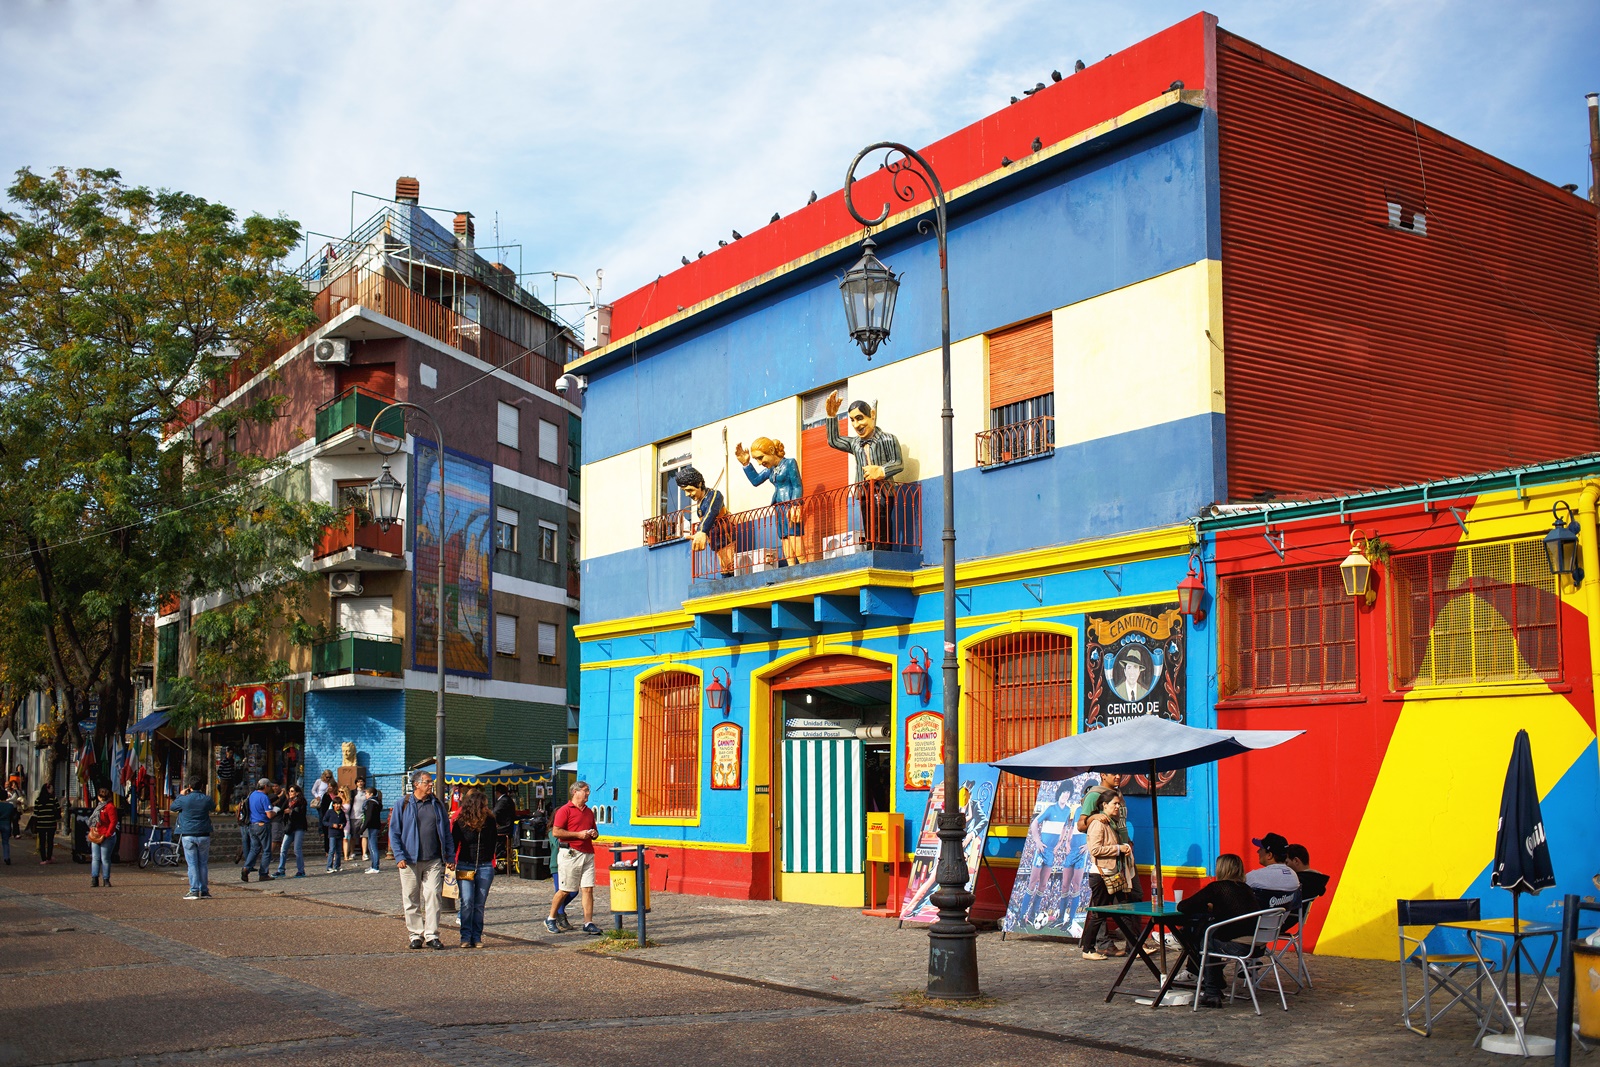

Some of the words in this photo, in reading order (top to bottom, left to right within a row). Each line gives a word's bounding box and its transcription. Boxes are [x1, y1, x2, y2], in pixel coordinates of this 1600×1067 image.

[1109, 615, 1159, 638] CAMINITO
[1107, 702, 1144, 715] CENTRO
[1146, 701, 1160, 713] DE
[912, 732, 938, 740] CAMINITO
[915, 849, 937, 857] CAMINITO
